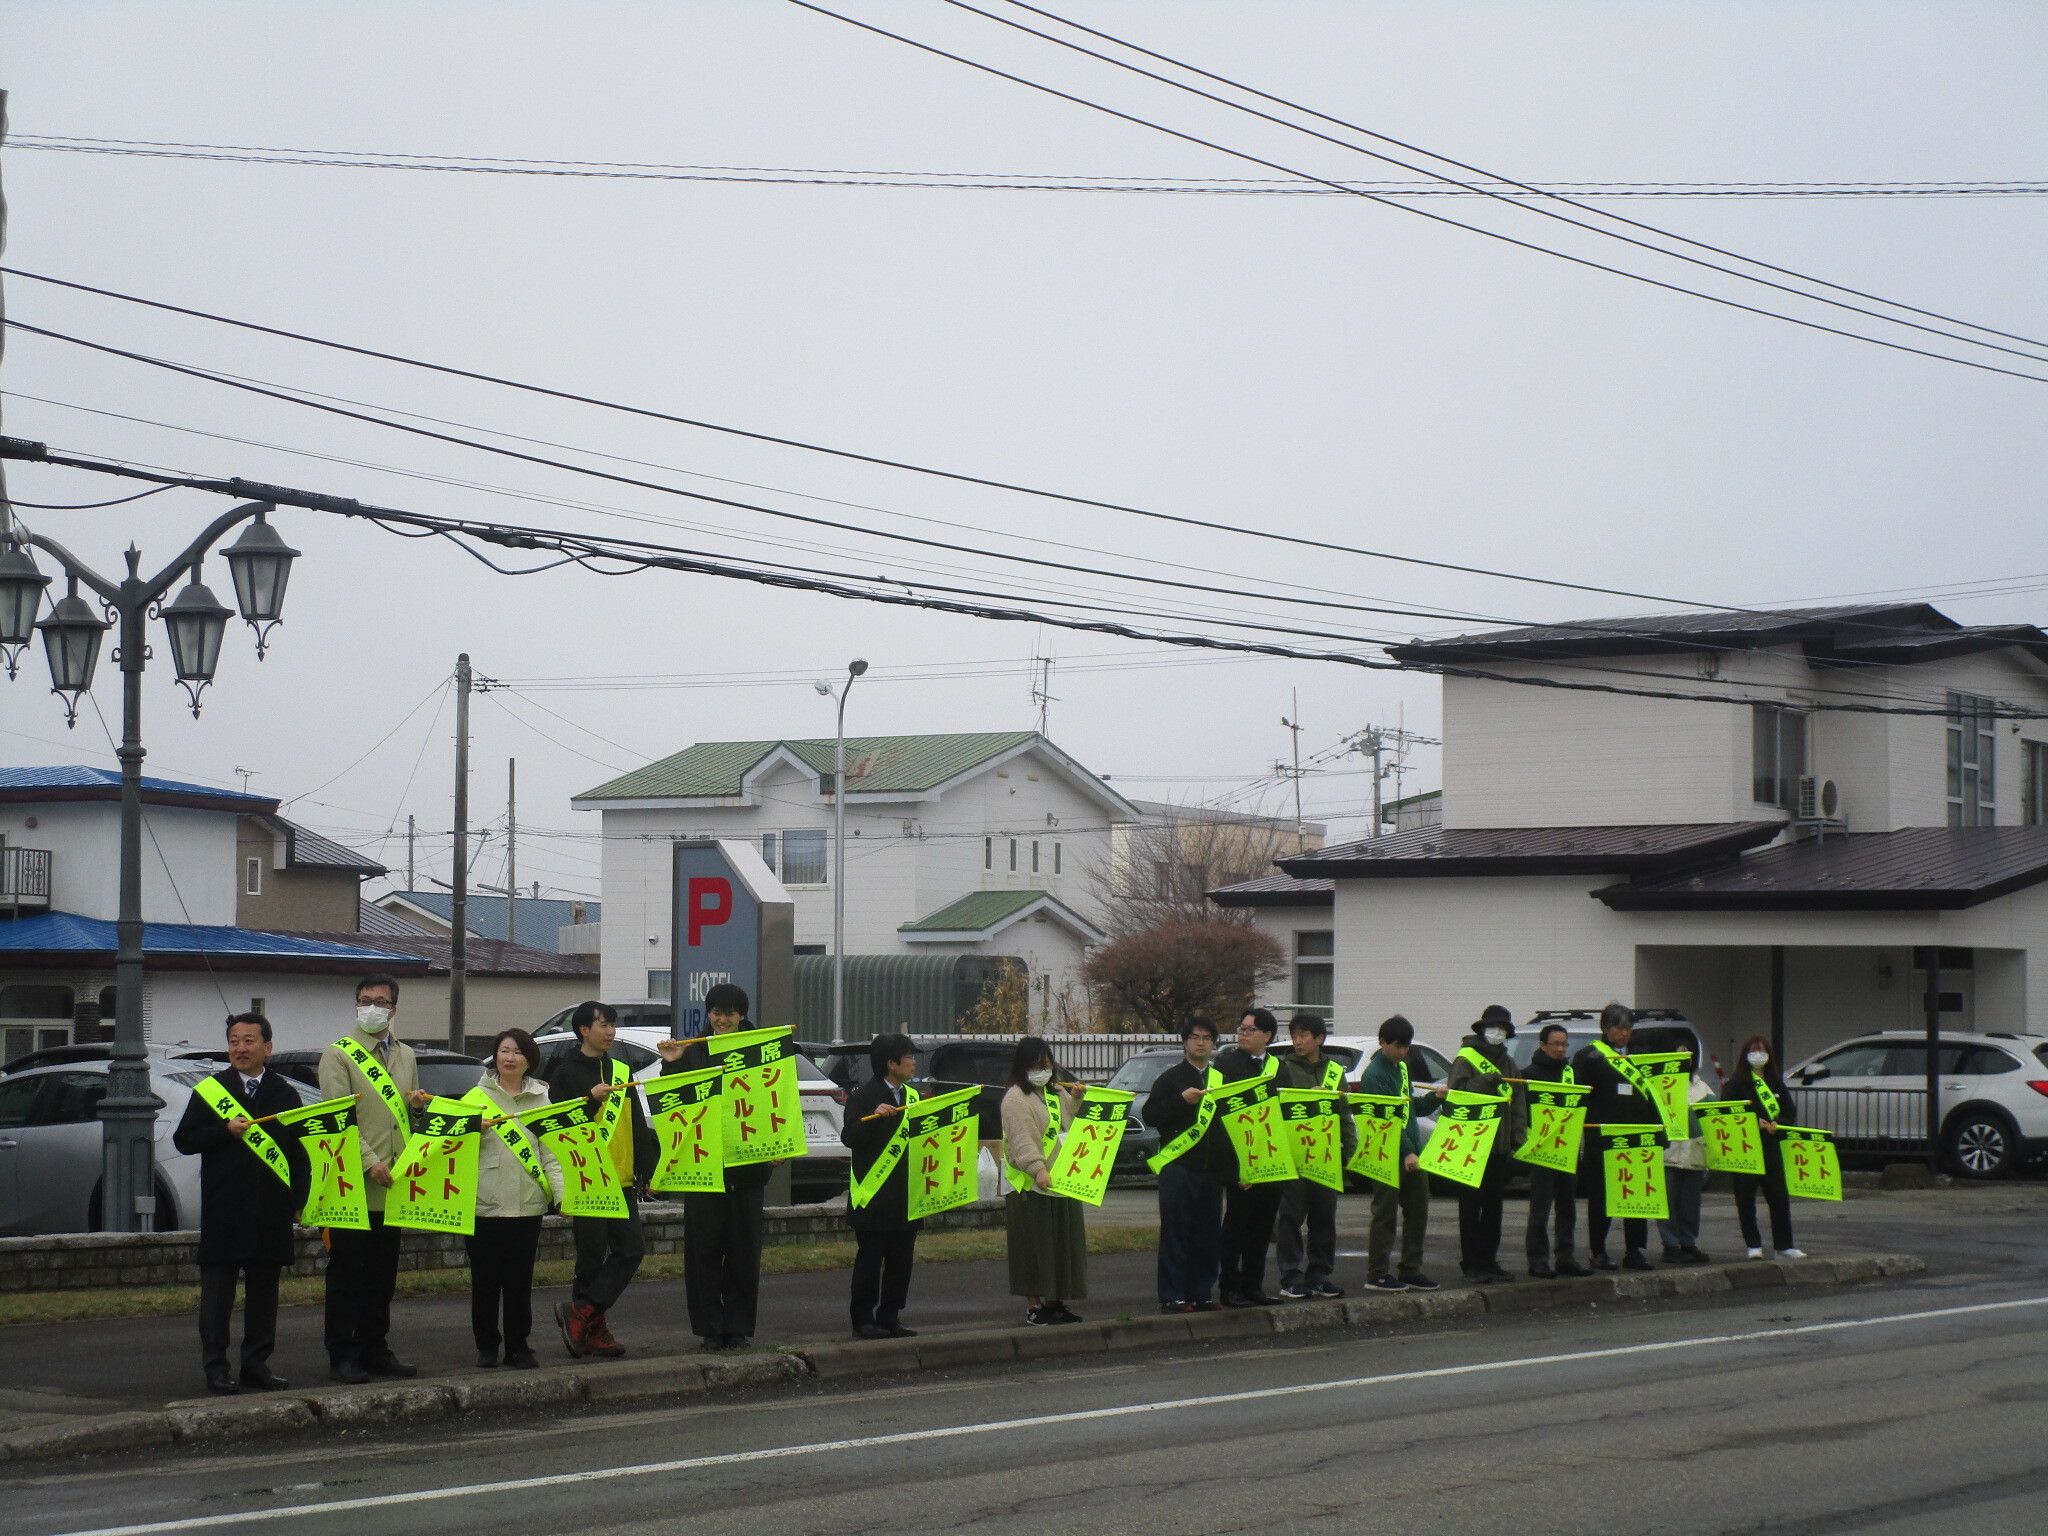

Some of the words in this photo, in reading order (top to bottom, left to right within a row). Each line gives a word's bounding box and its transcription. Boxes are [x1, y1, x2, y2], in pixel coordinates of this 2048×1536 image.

[688, 877, 733, 946] P
[690, 971, 731, 1001] HOT
[335, 1039, 396, 1101] 交通安全
[723, 1041, 782, 1073] 全席
[659, 1080, 714, 1111] 全席
[730, 1074, 757, 1141] ベルト
[761, 1067, 787, 1133] シート
[920, 1101, 970, 1134] 全席
[1085, 1103, 1128, 1121] 全席
[1187, 1086, 1214, 1142] 通安全
[1227, 1084, 1269, 1112] 全席
[1290, 1100, 1332, 1119] 全席
[1451, 1105, 1497, 1120] 全席
[1538, 1093, 1582, 1107] 全席
[217, 1096, 280, 1164] 交安全
[425, 1115, 470, 1135] 全席
[539, 1108, 590, 1132] 全席
[1237, 1110, 1259, 1167] ベルト
[1258, 1106, 1278, 1158] シート
[1295, 1122, 1316, 1164] ベルト
[1321, 1117, 1334, 1163] シート
[1437, 1123, 1467, 1163] ベルト
[1555, 1110, 1574, 1149] シート
[1612, 1133, 1656, 1149] 全席
[1711, 1116, 1733, 1157] ベルト
[1733, 1115, 1754, 1154] シート
[492, 1114, 542, 1179] 交通安全
[558, 1131, 593, 1192] ベルト
[580, 1126, 611, 1188] シート
[921, 1133, 940, 1195] ベルト
[951, 1125, 968, 1185] シート
[1067, 1124, 1099, 1177] ベルト
[1090, 1124, 1118, 1180] シート
[1463, 1122, 1489, 1168] シート
[1791, 1142, 1811, 1181] ベルト
[1813, 1142, 1832, 1180] シート
[318, 1138, 336, 1201] ベル
[441, 1140, 464, 1200] シート
[1616, 1151, 1635, 1200] ベルト
[1641, 1149, 1658, 1197] シート
